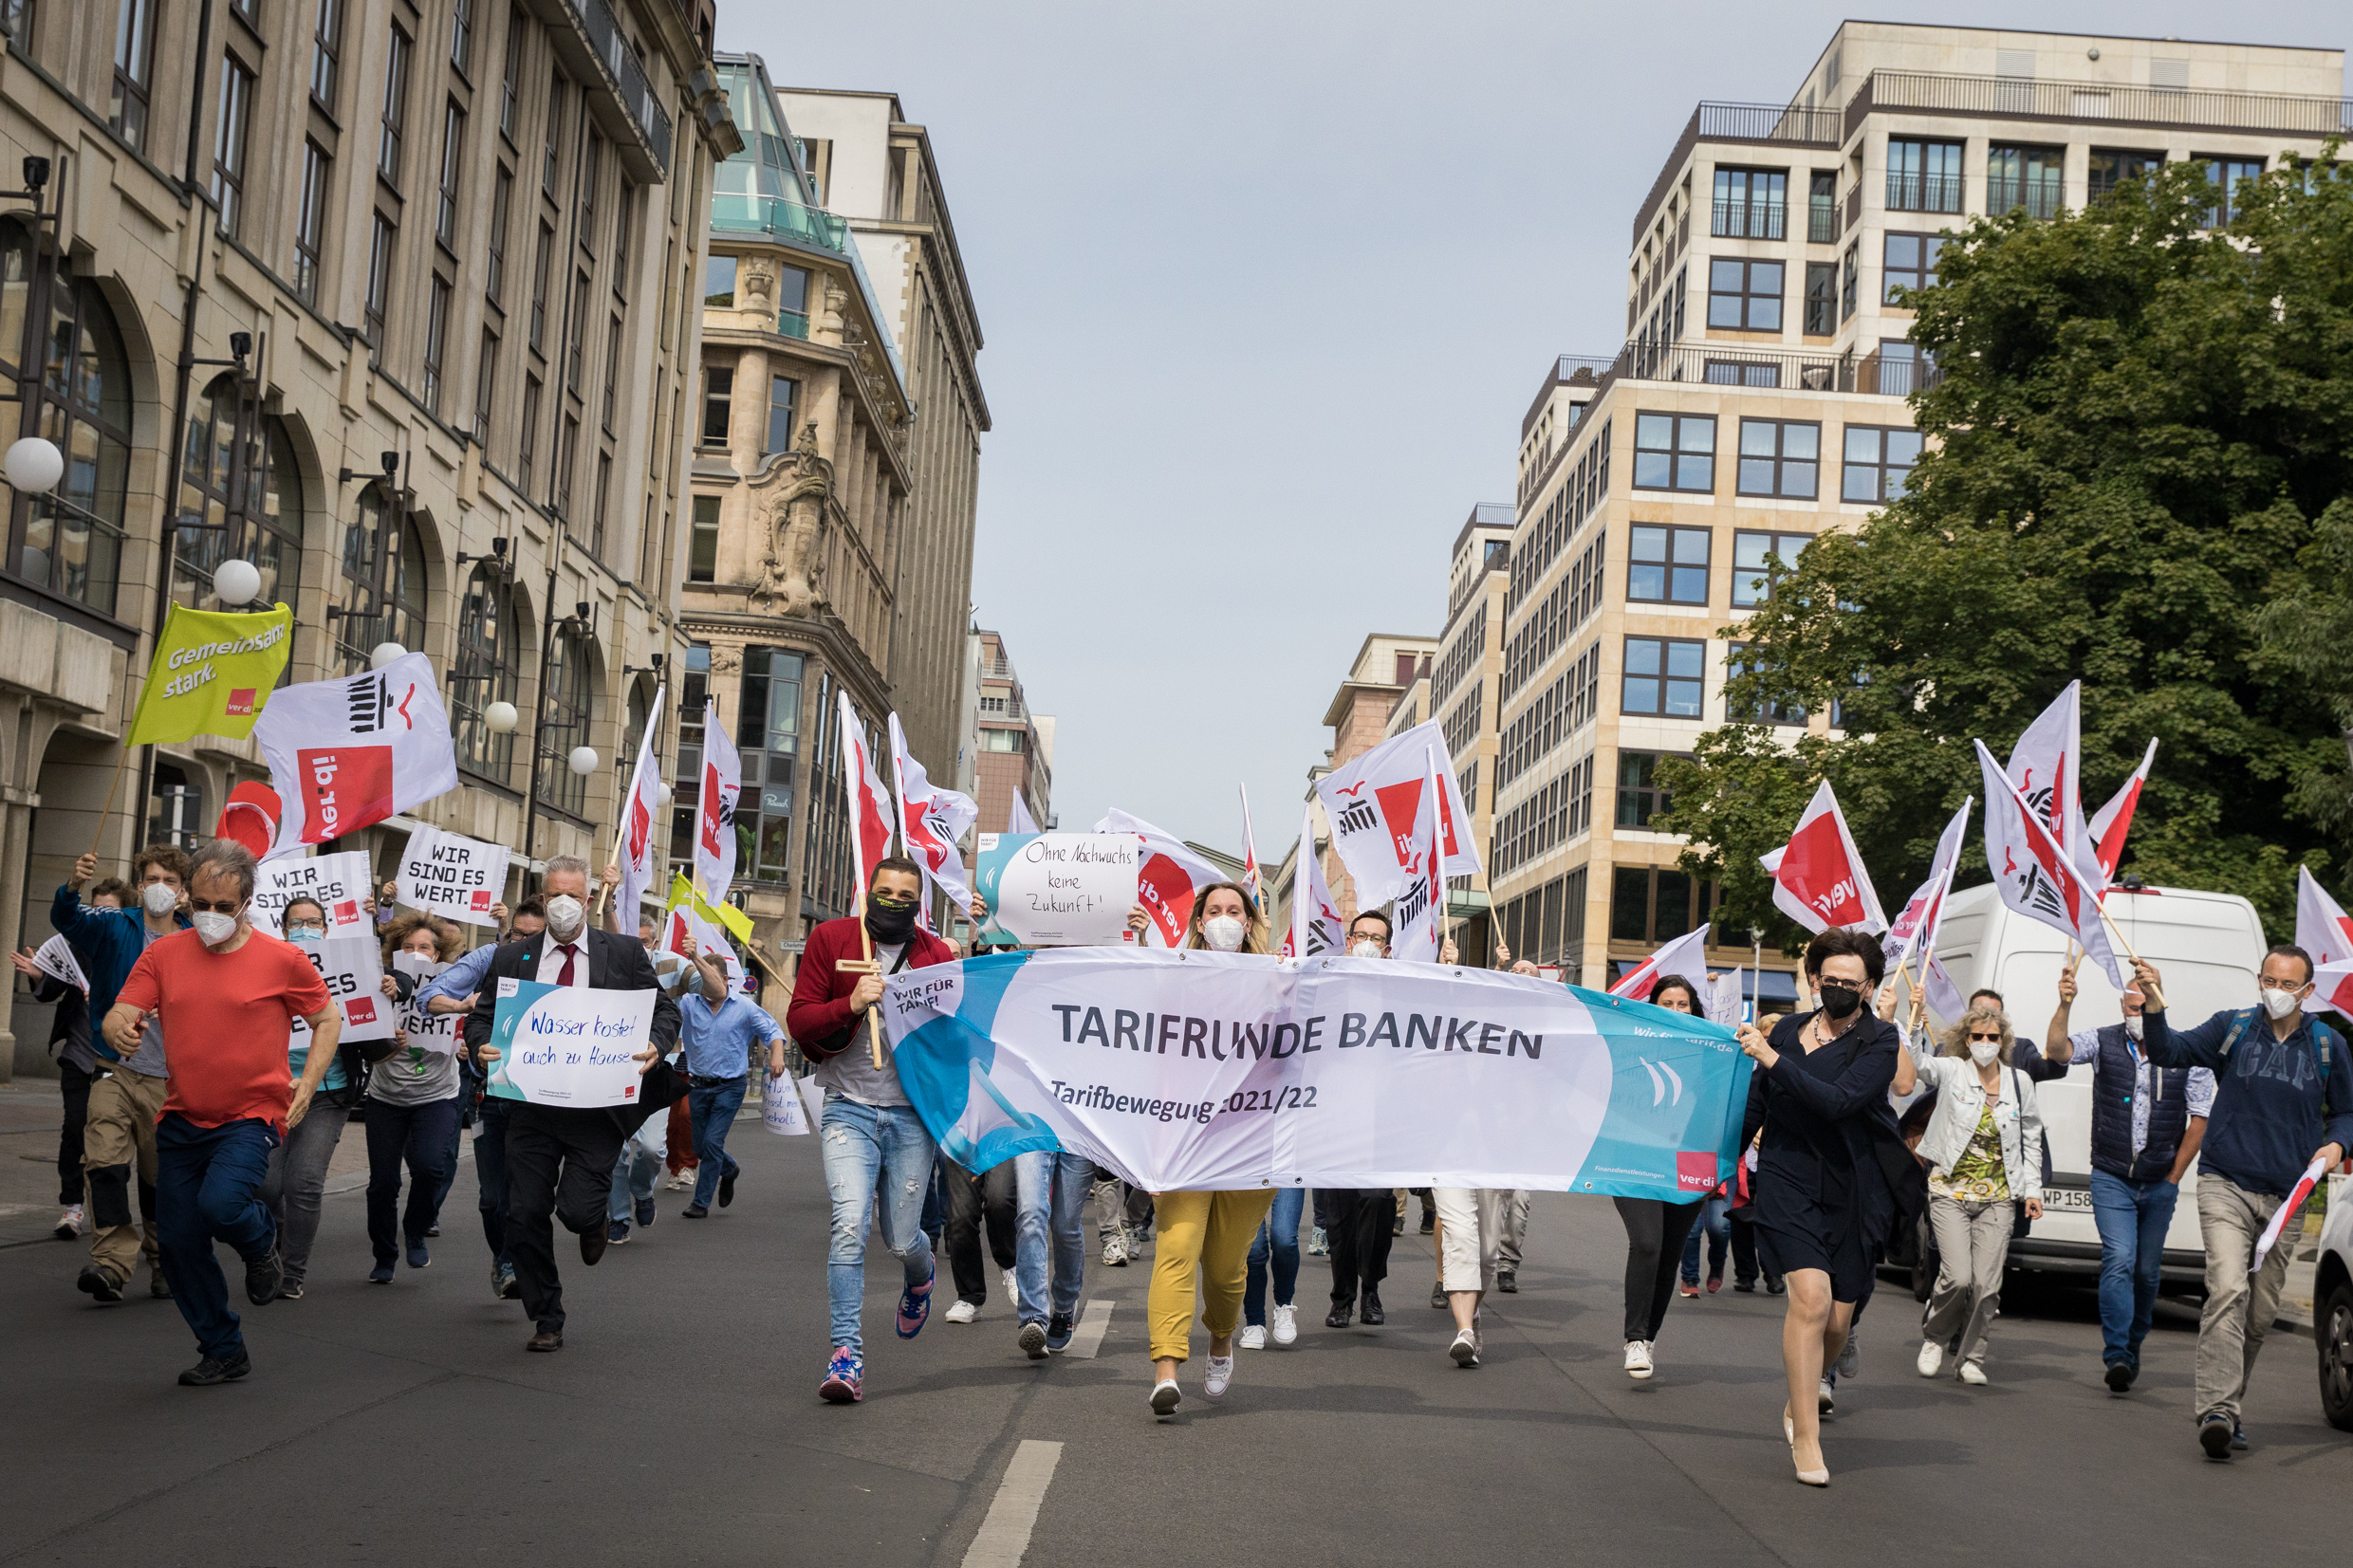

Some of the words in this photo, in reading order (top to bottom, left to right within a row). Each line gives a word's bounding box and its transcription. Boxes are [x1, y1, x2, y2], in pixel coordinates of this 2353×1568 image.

[168, 622, 285, 670] Gemeinsam
[162, 662, 217, 698] stark.
[228, 703, 252, 713] ver.di
[432, 844, 471, 864] WIR
[1026, 841, 1065, 863] Ohne
[1070, 842, 1132, 865] Nachwuchs
[272, 867, 318, 888] WIR
[408, 861, 457, 883] SIND
[462, 870, 485, 885] ES
[1048, 870, 1082, 889] keine
[316, 881, 344, 902] ES
[415, 883, 469, 905] WERT.
[1026, 893, 1104, 913] Zukunft!
[324, 972, 357, 997] ES
[893, 987, 921, 1002] WIR
[925, 979, 954, 994] FÜR
[350, 1012, 375, 1022] ver.di
[531, 1011, 589, 1036] Wasser
[593, 1014, 638, 1037] kostet
[1051, 1004, 1326, 1062] TARIFRUNDE
[1339, 1012, 1543, 1060] BANKEN
[523, 1045, 556, 1065] auch
[565, 1052, 582, 1065] zu
[589, 1045, 631, 1065] Hause
[2236, 1042, 2315, 1091] GAP
[1594, 1165, 1666, 1179] Finanzdienstleistungen
[1679, 1174, 1714, 1187] ver.di
[2043, 1190, 2062, 1205] WP
[2065, 1192, 2092, 1208] 158
